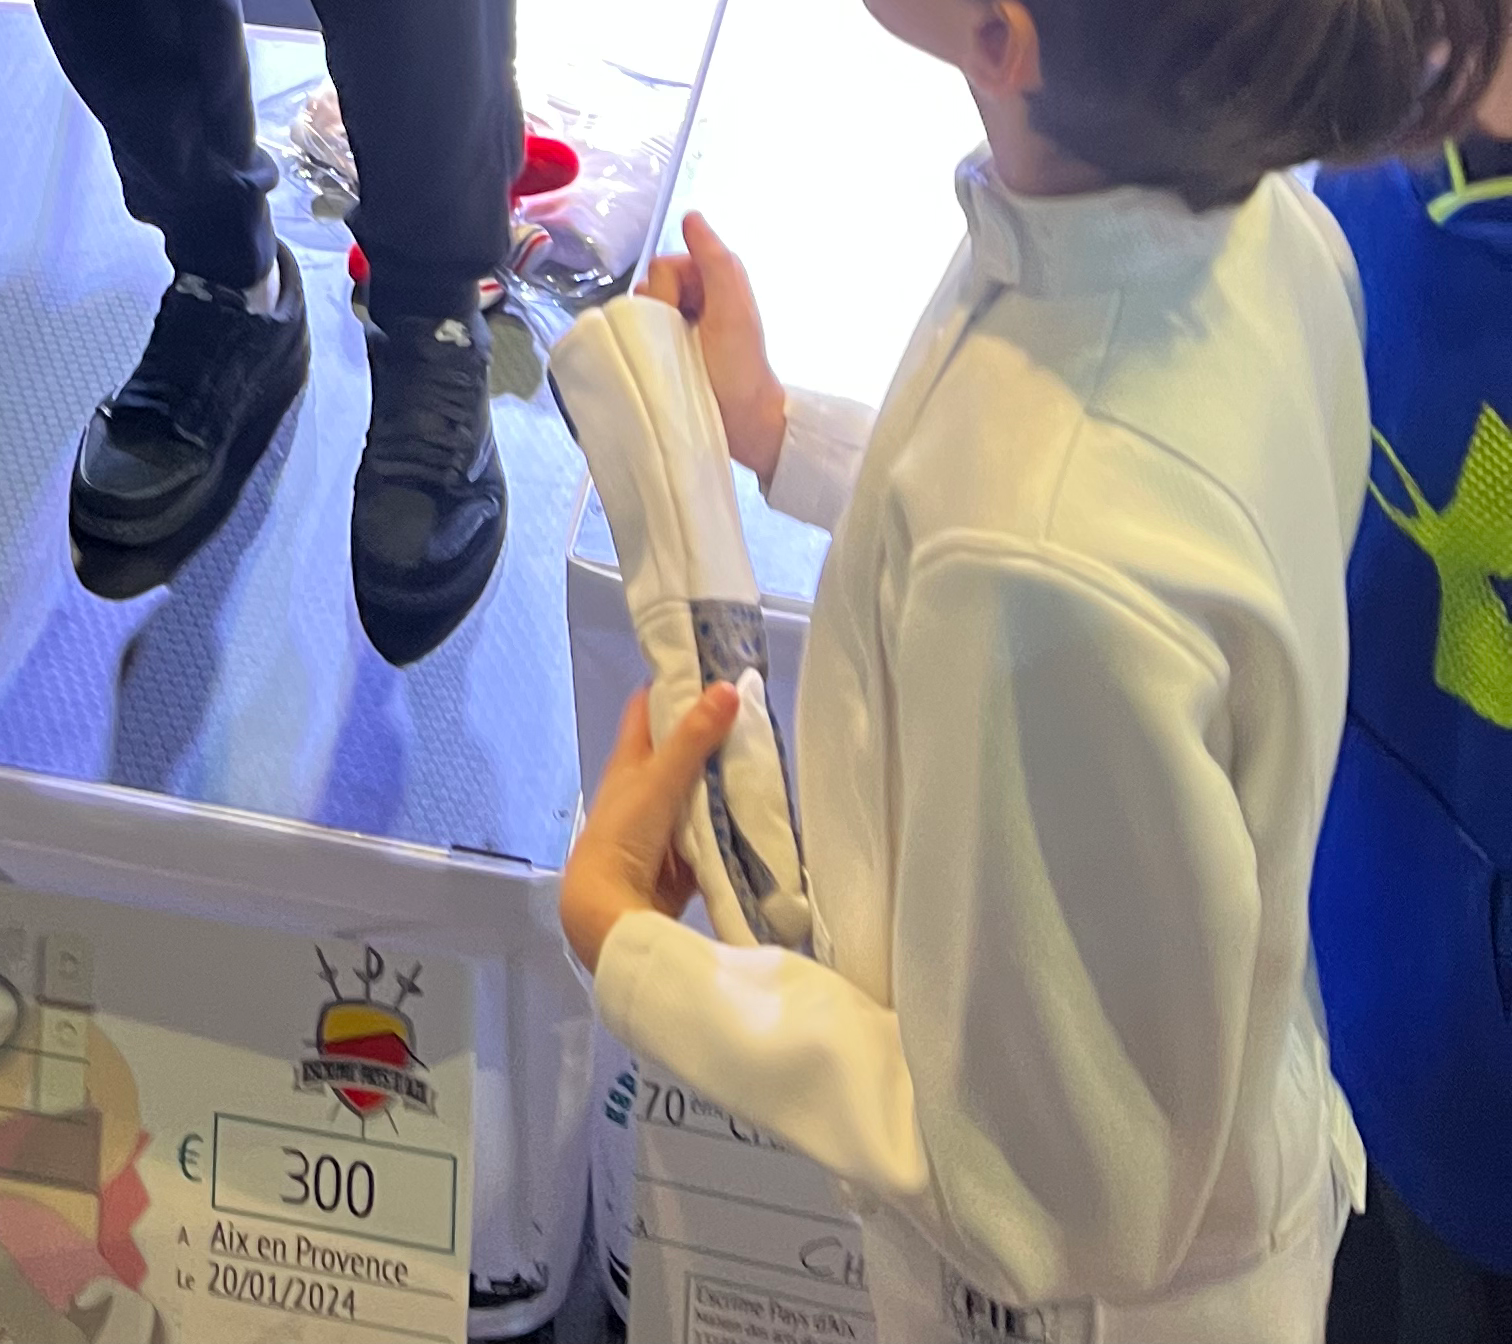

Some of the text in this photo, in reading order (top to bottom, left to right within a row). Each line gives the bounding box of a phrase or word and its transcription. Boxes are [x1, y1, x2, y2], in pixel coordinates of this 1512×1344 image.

[280, 1145, 375, 1219] 300
[211, 1219, 251, 1256] Aix
[257, 1234, 287, 1263] en
[296, 1234, 409, 1288] Provence
[208, 1261, 356, 1321] 20/01/2024
